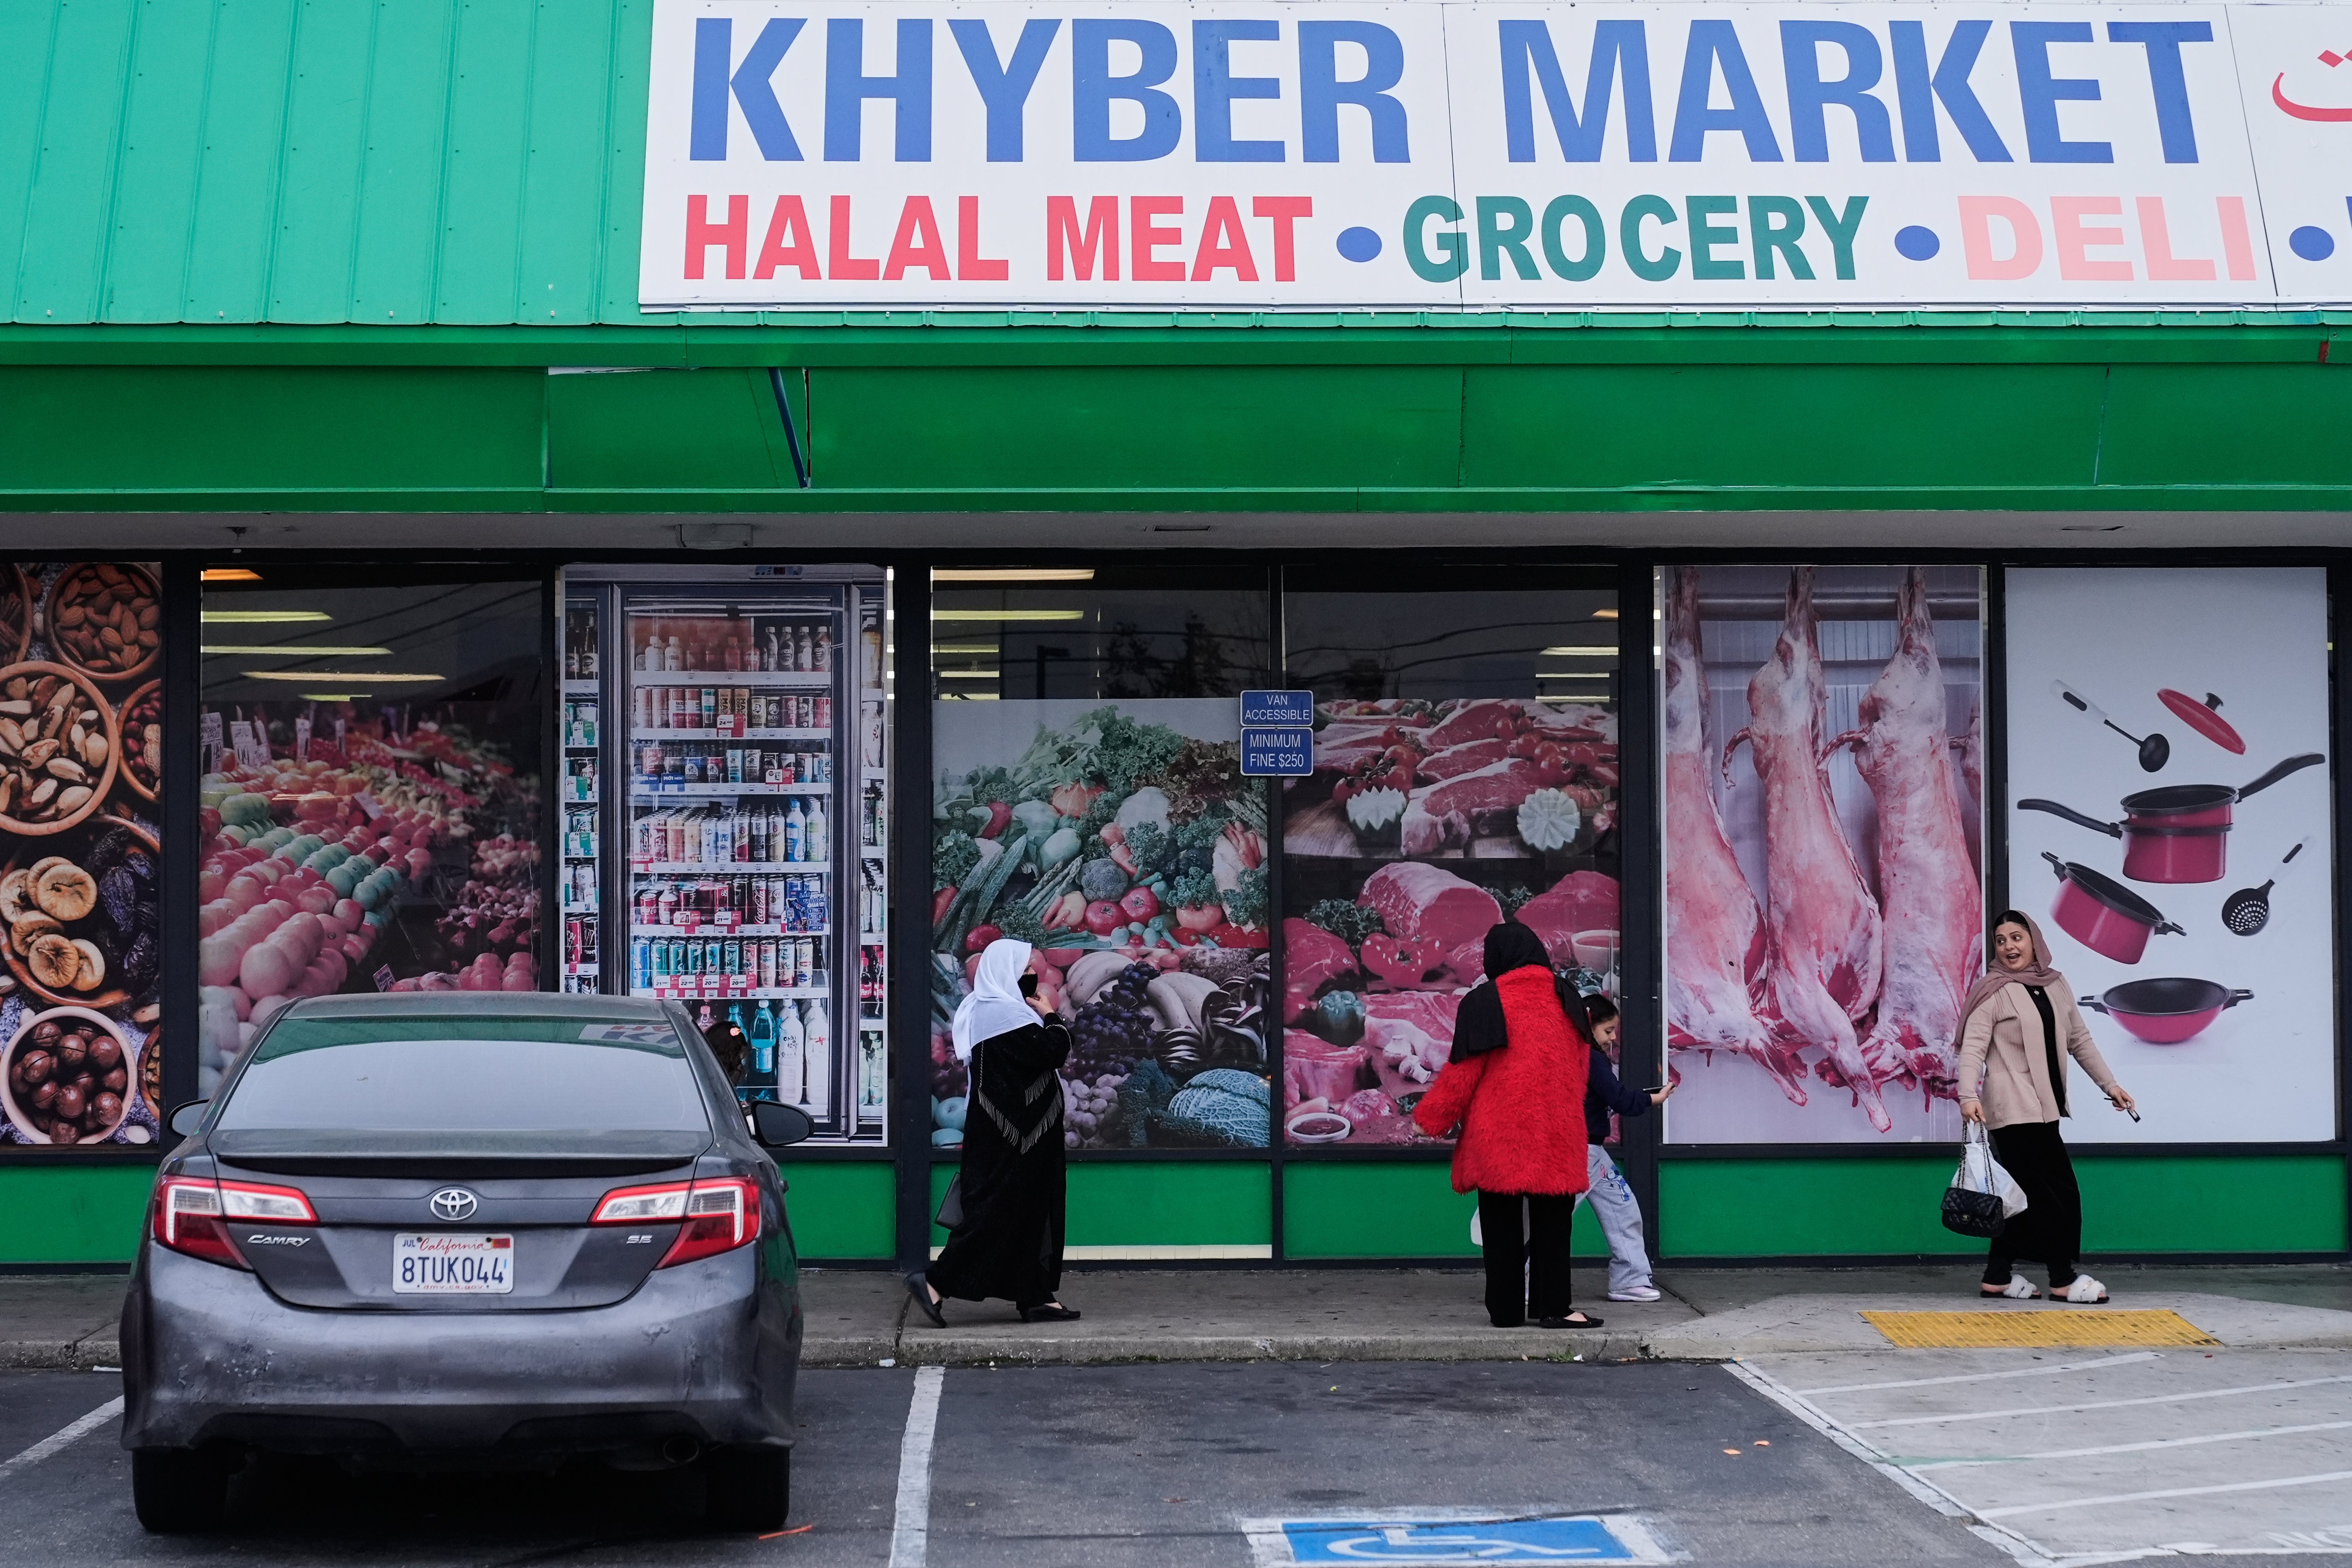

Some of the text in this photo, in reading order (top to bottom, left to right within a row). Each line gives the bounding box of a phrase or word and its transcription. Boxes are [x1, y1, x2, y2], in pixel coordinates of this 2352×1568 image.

[690, 18, 1411, 163] KHYBER
[1499, 20, 2214, 164] MARKET
[684, 195, 2256, 282] HALAL MEAT GROCERY DELI
[1266, 695, 1288, 705] VAN
[1244, 709, 1310, 720] ACCESSIBLE
[1249, 734, 1300, 747] MINIMUM
[1250, 753, 1304, 769] FINE $250
[247, 1234, 311, 1247] CAMRY
[419, 1238, 484, 1255] California
[626, 1235, 652, 1244] SE
[402, 1257, 503, 1283] 8TUK044
